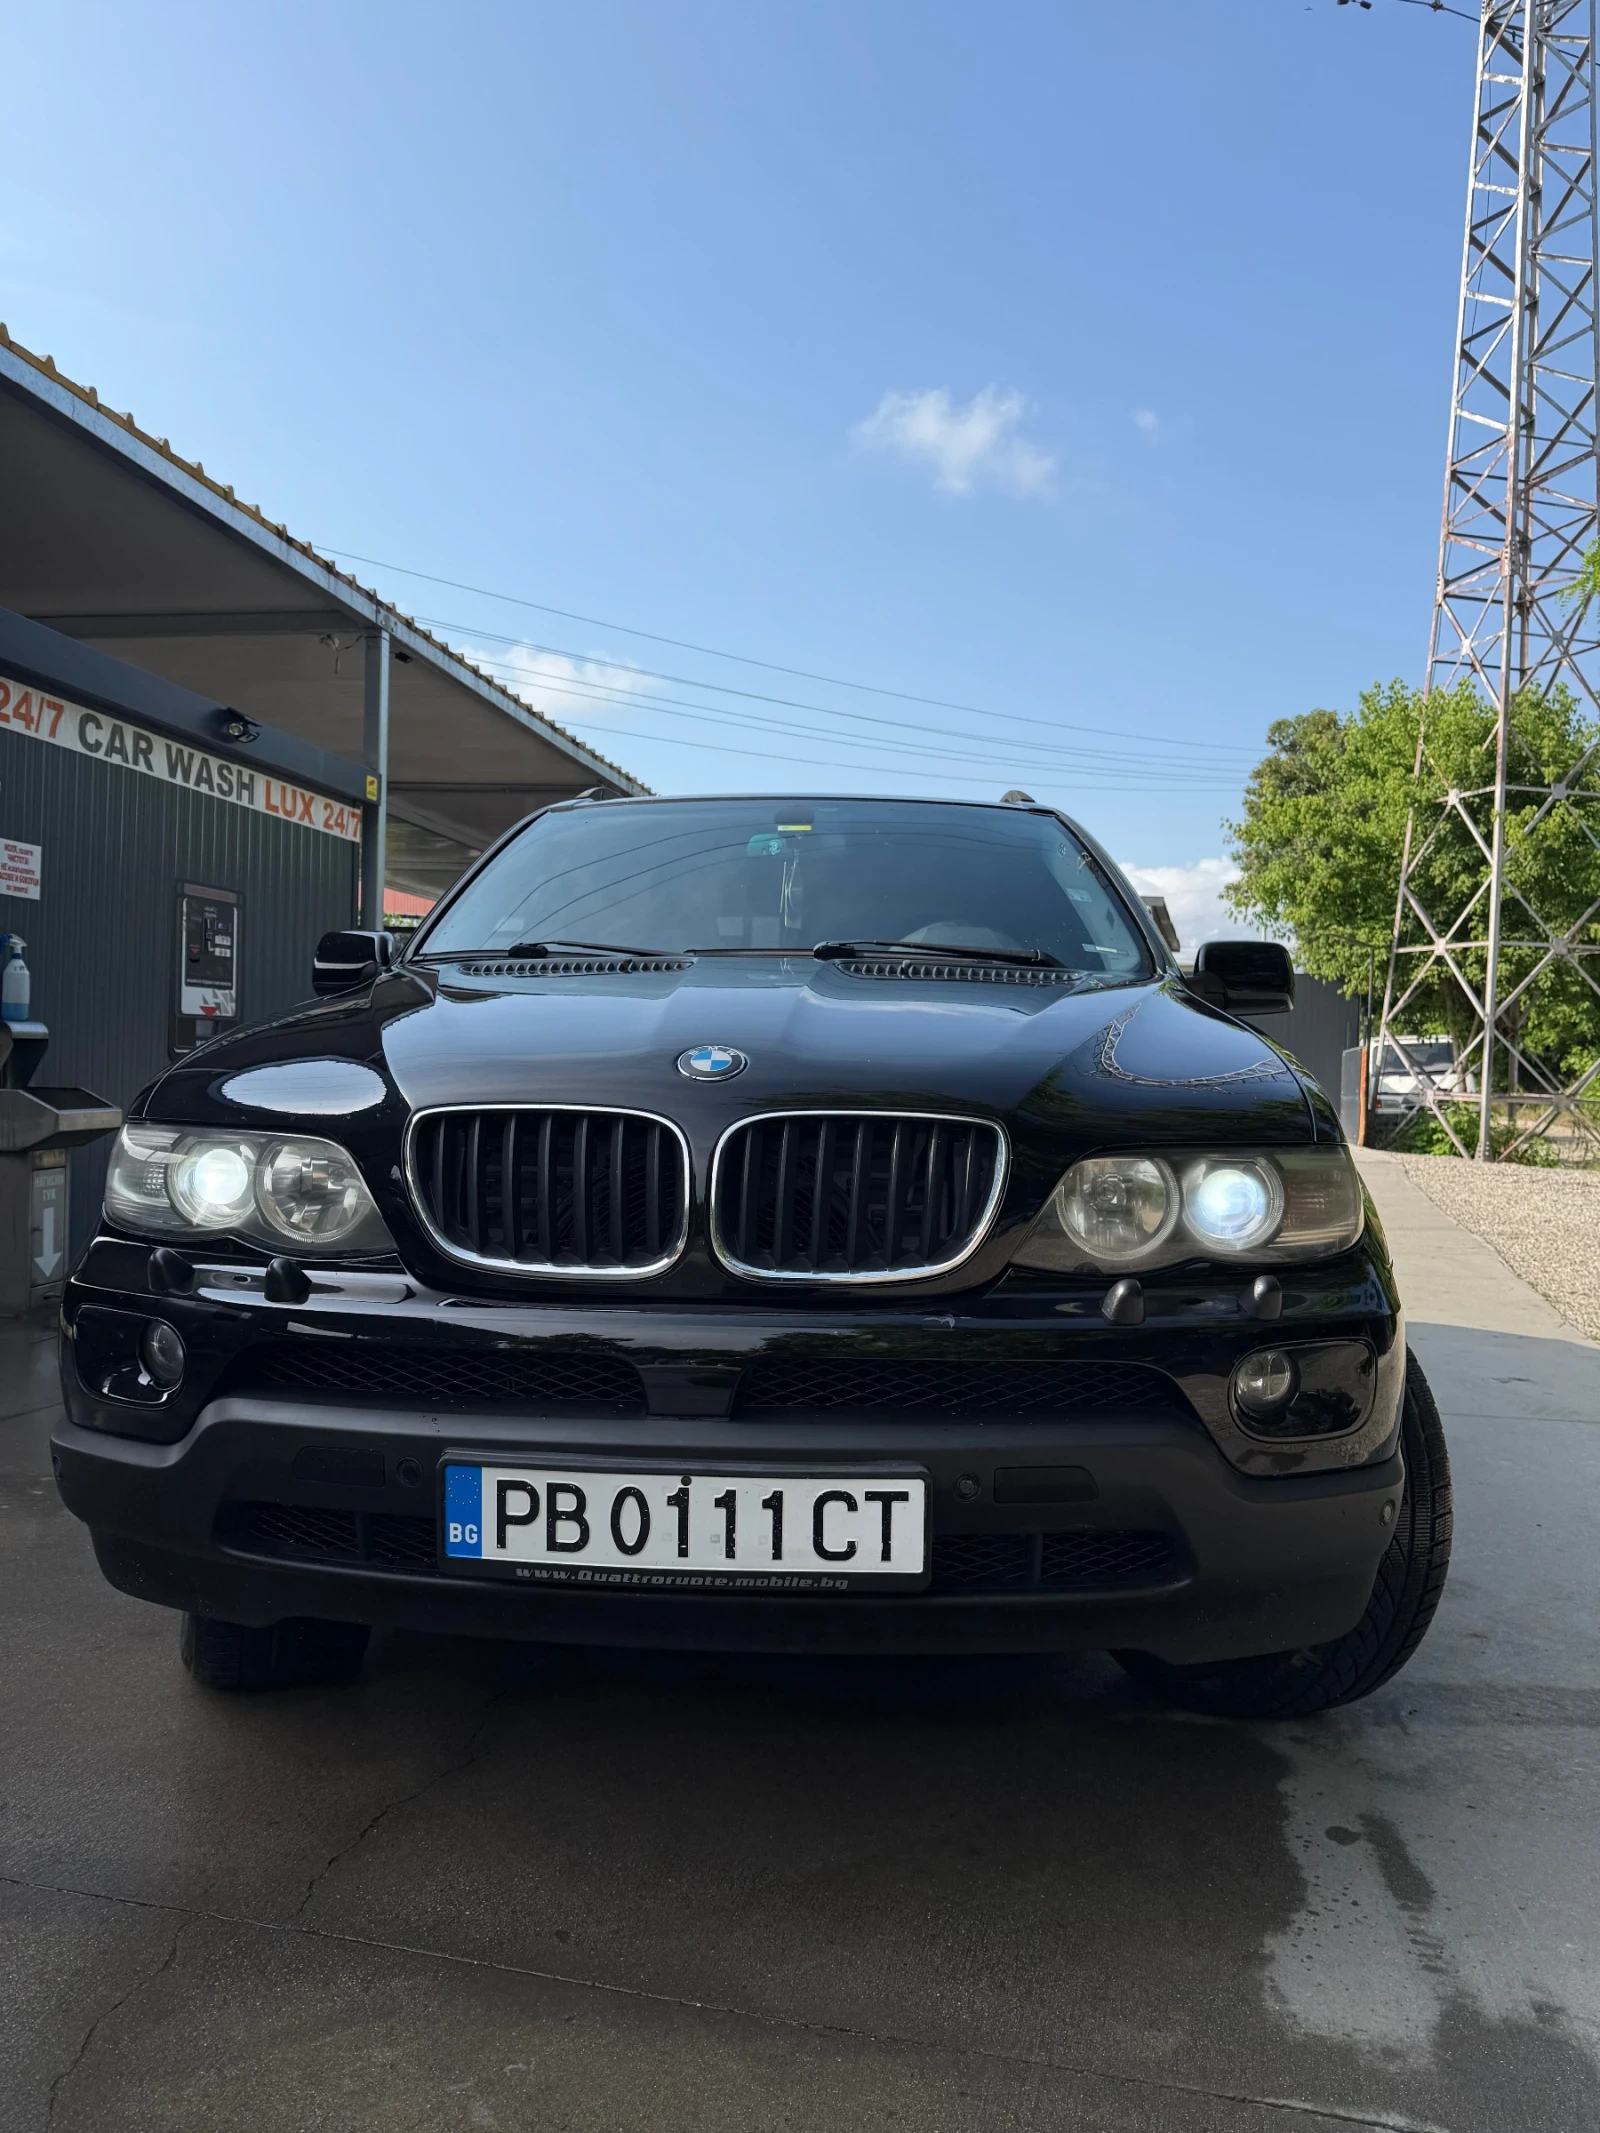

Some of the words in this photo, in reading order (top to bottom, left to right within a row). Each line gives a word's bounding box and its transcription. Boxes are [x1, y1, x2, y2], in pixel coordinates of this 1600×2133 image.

[0, 681, 65, 739] 24/7
[78, 712, 154, 772] CAR
[165, 742, 255, 806] WASH
[264, 779, 315, 826] LUX
[322, 802, 361, 838] 24/7
[449, 1522, 479, 1545] BG
[496, 1479, 591, 1553] PB
[812, 1489, 910, 1562] CT
[515, 1567, 849, 1590] www.Quattroruote.mobile.bg
